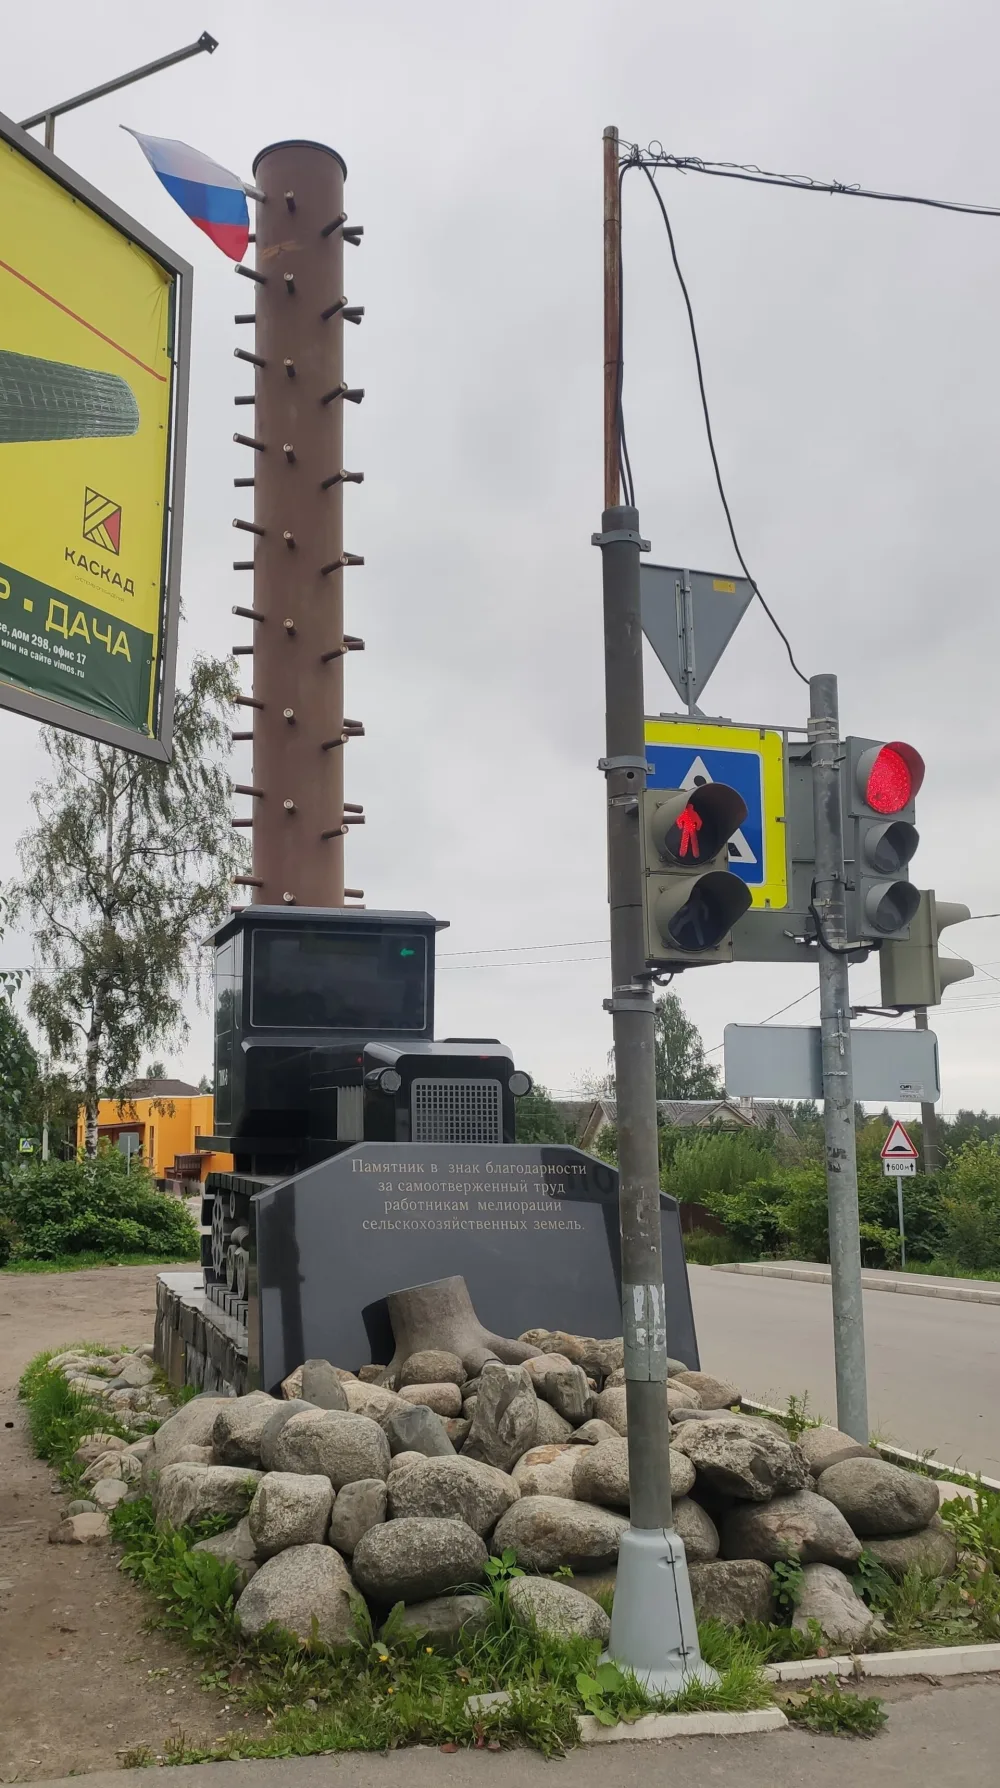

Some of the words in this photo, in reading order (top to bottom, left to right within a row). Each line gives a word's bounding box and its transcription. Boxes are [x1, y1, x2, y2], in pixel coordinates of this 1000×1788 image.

[64, 546, 135, 597] КАСКАД
[45, 598, 132, 663] ДАЧА
[11, 628, 29, 643] дом
[31, 634, 51, 653] 298,
[53, 645, 75, 660] офис
[76, 653, 87, 665] 17
[1, 639, 17, 652] или
[19, 646, 28, 656] на
[30, 651, 52, 665] сайте
[53, 660, 85, 679] vimos.ru
[352, 1159, 424, 1174] Памятник
[431, 1164, 438, 1173] в
[448, 1164, 480, 1174] знак
[486, 1161, 587, 1177] благодарности
[891, 1163, 904, 1171] 600
[378, 1182, 393, 1192] за
[398, 1180, 528, 1195] самоотверженный
[534, 1183, 566, 1196] труд
[384, 1198, 469, 1214] работникам
[478, 1200, 562, 1214] мелиорации
[362, 1217, 528, 1231] сельскохозяйственных
[533, 1219, 585, 1231] земель.
